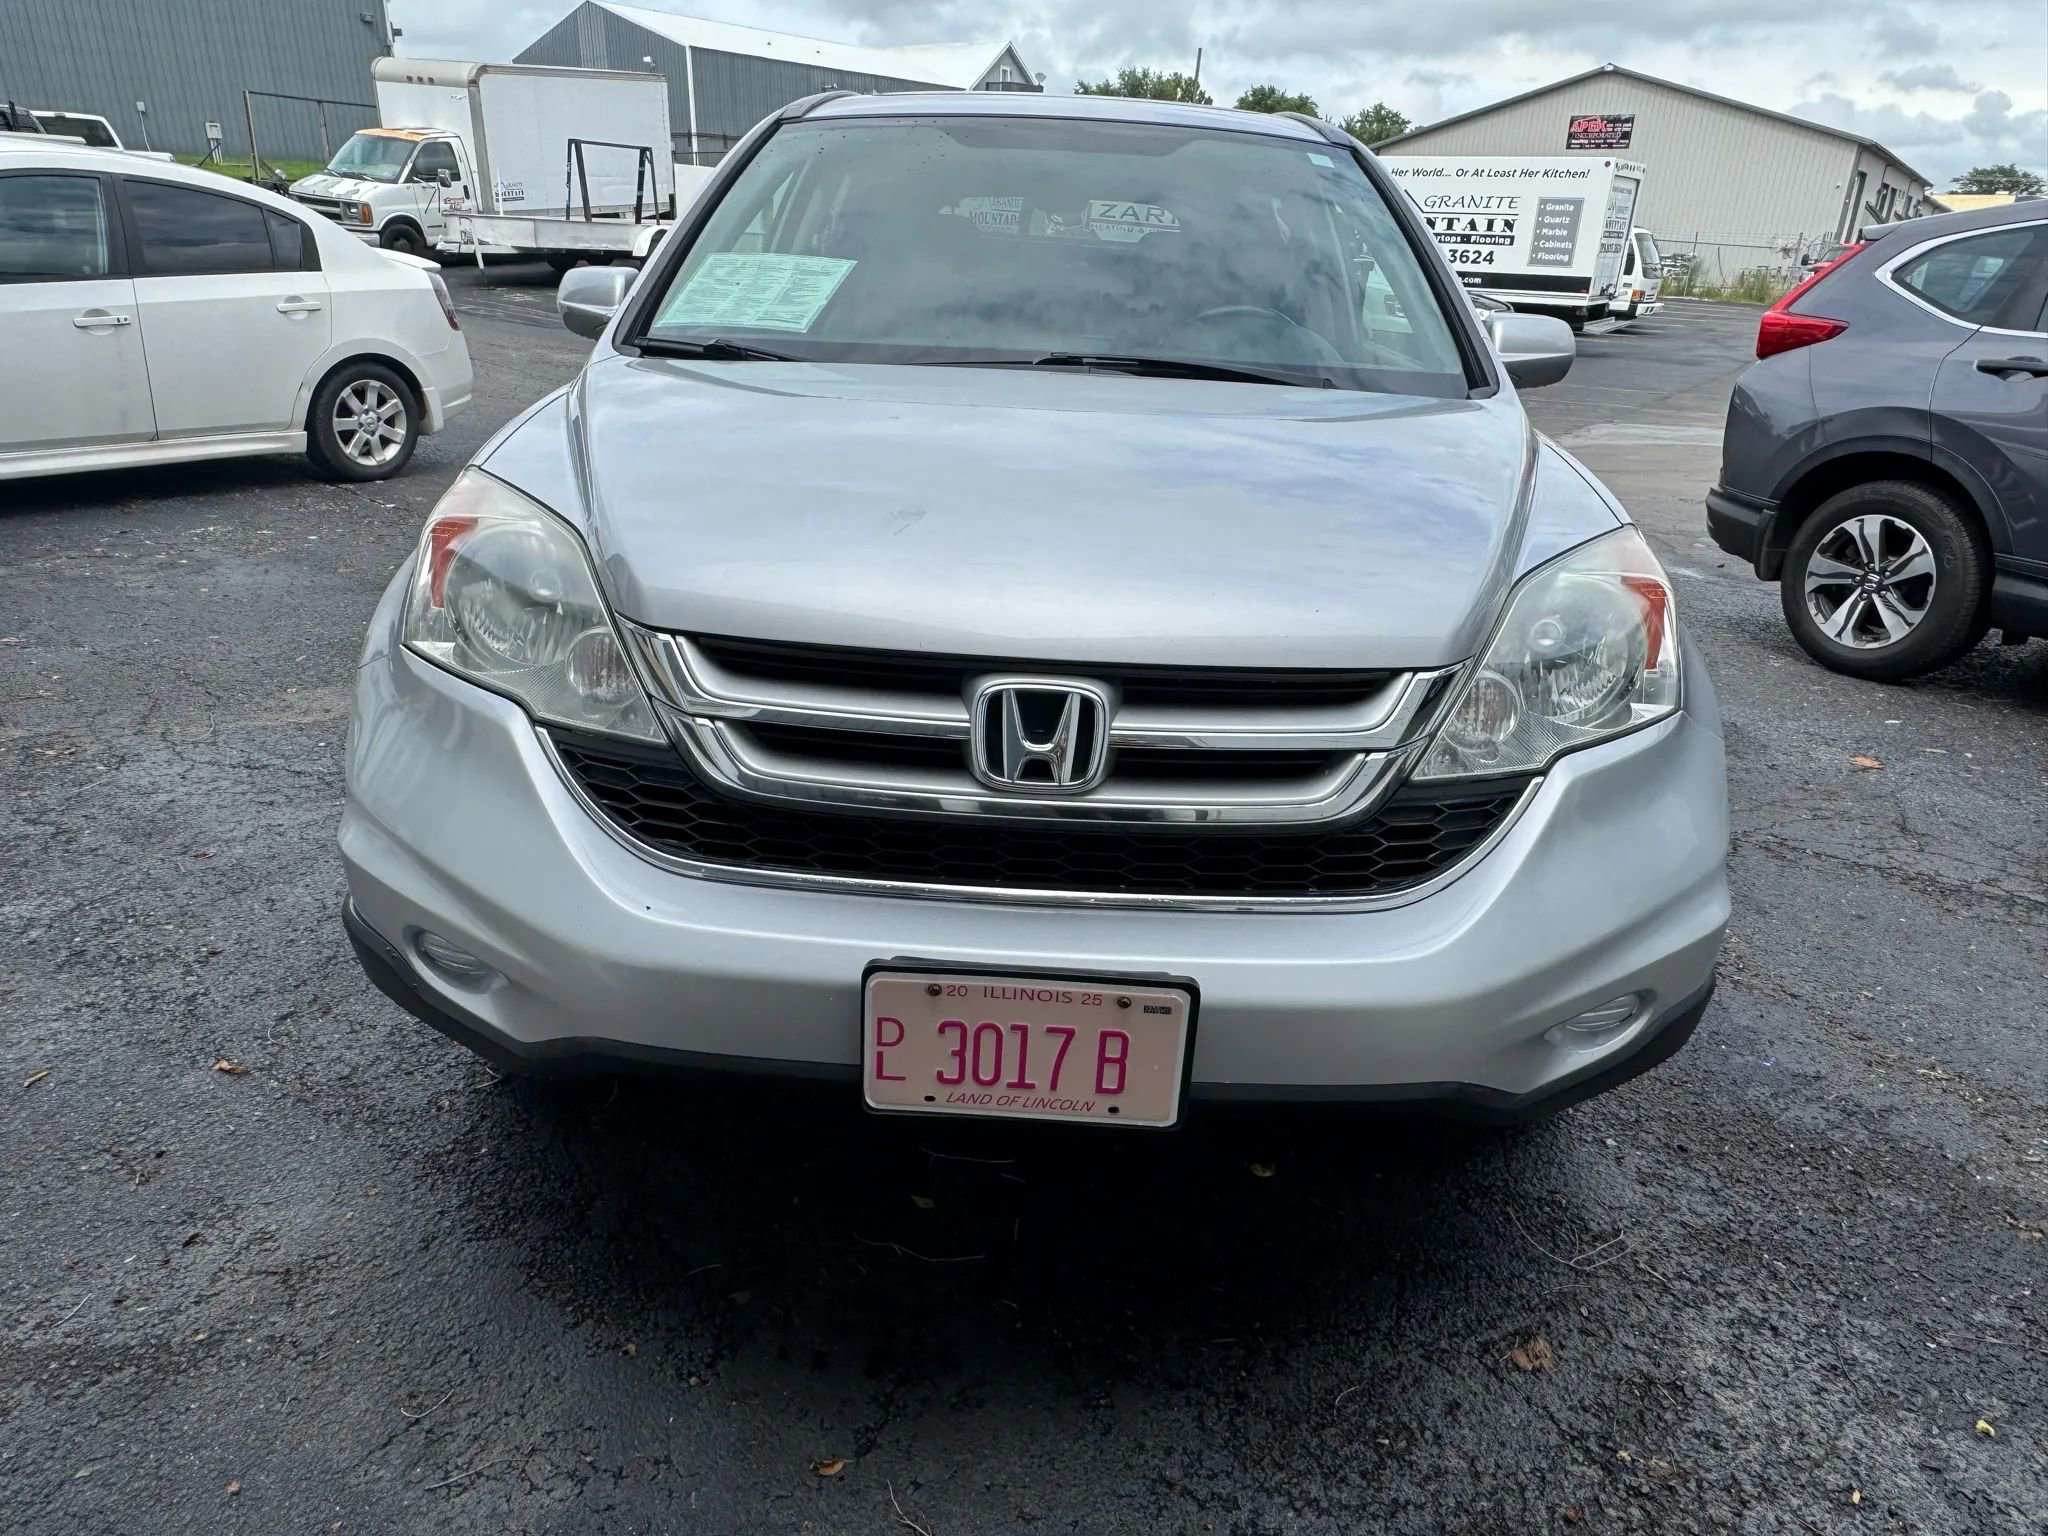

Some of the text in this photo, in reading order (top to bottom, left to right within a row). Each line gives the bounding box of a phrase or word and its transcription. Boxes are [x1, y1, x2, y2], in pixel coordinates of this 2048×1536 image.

[1391, 167, 1591, 179] Her World... Or At Least Her Kitchen!
[1424, 195, 1521, 209] GRANITE
[1546, 203, 1574, 211] Granite
[1543, 216, 1570, 224] Quartz
[1541, 228, 1568, 236] Marble
[1470, 235, 1511, 245] Flooring
[1539, 240, 1573, 249] Cabinets
[1448, 248, 1495, 265] 3624
[1537, 252, 1569, 262] Flooring
[1459, 276, 1482, 284] .com
[946, 985, 1103, 1007] 20 ILLINOIS 25
[936, 1020, 1076, 1092] 3017
[1094, 1029, 1130, 1095] B
[946, 1092, 1096, 1113] LAND OF LINCOLN
